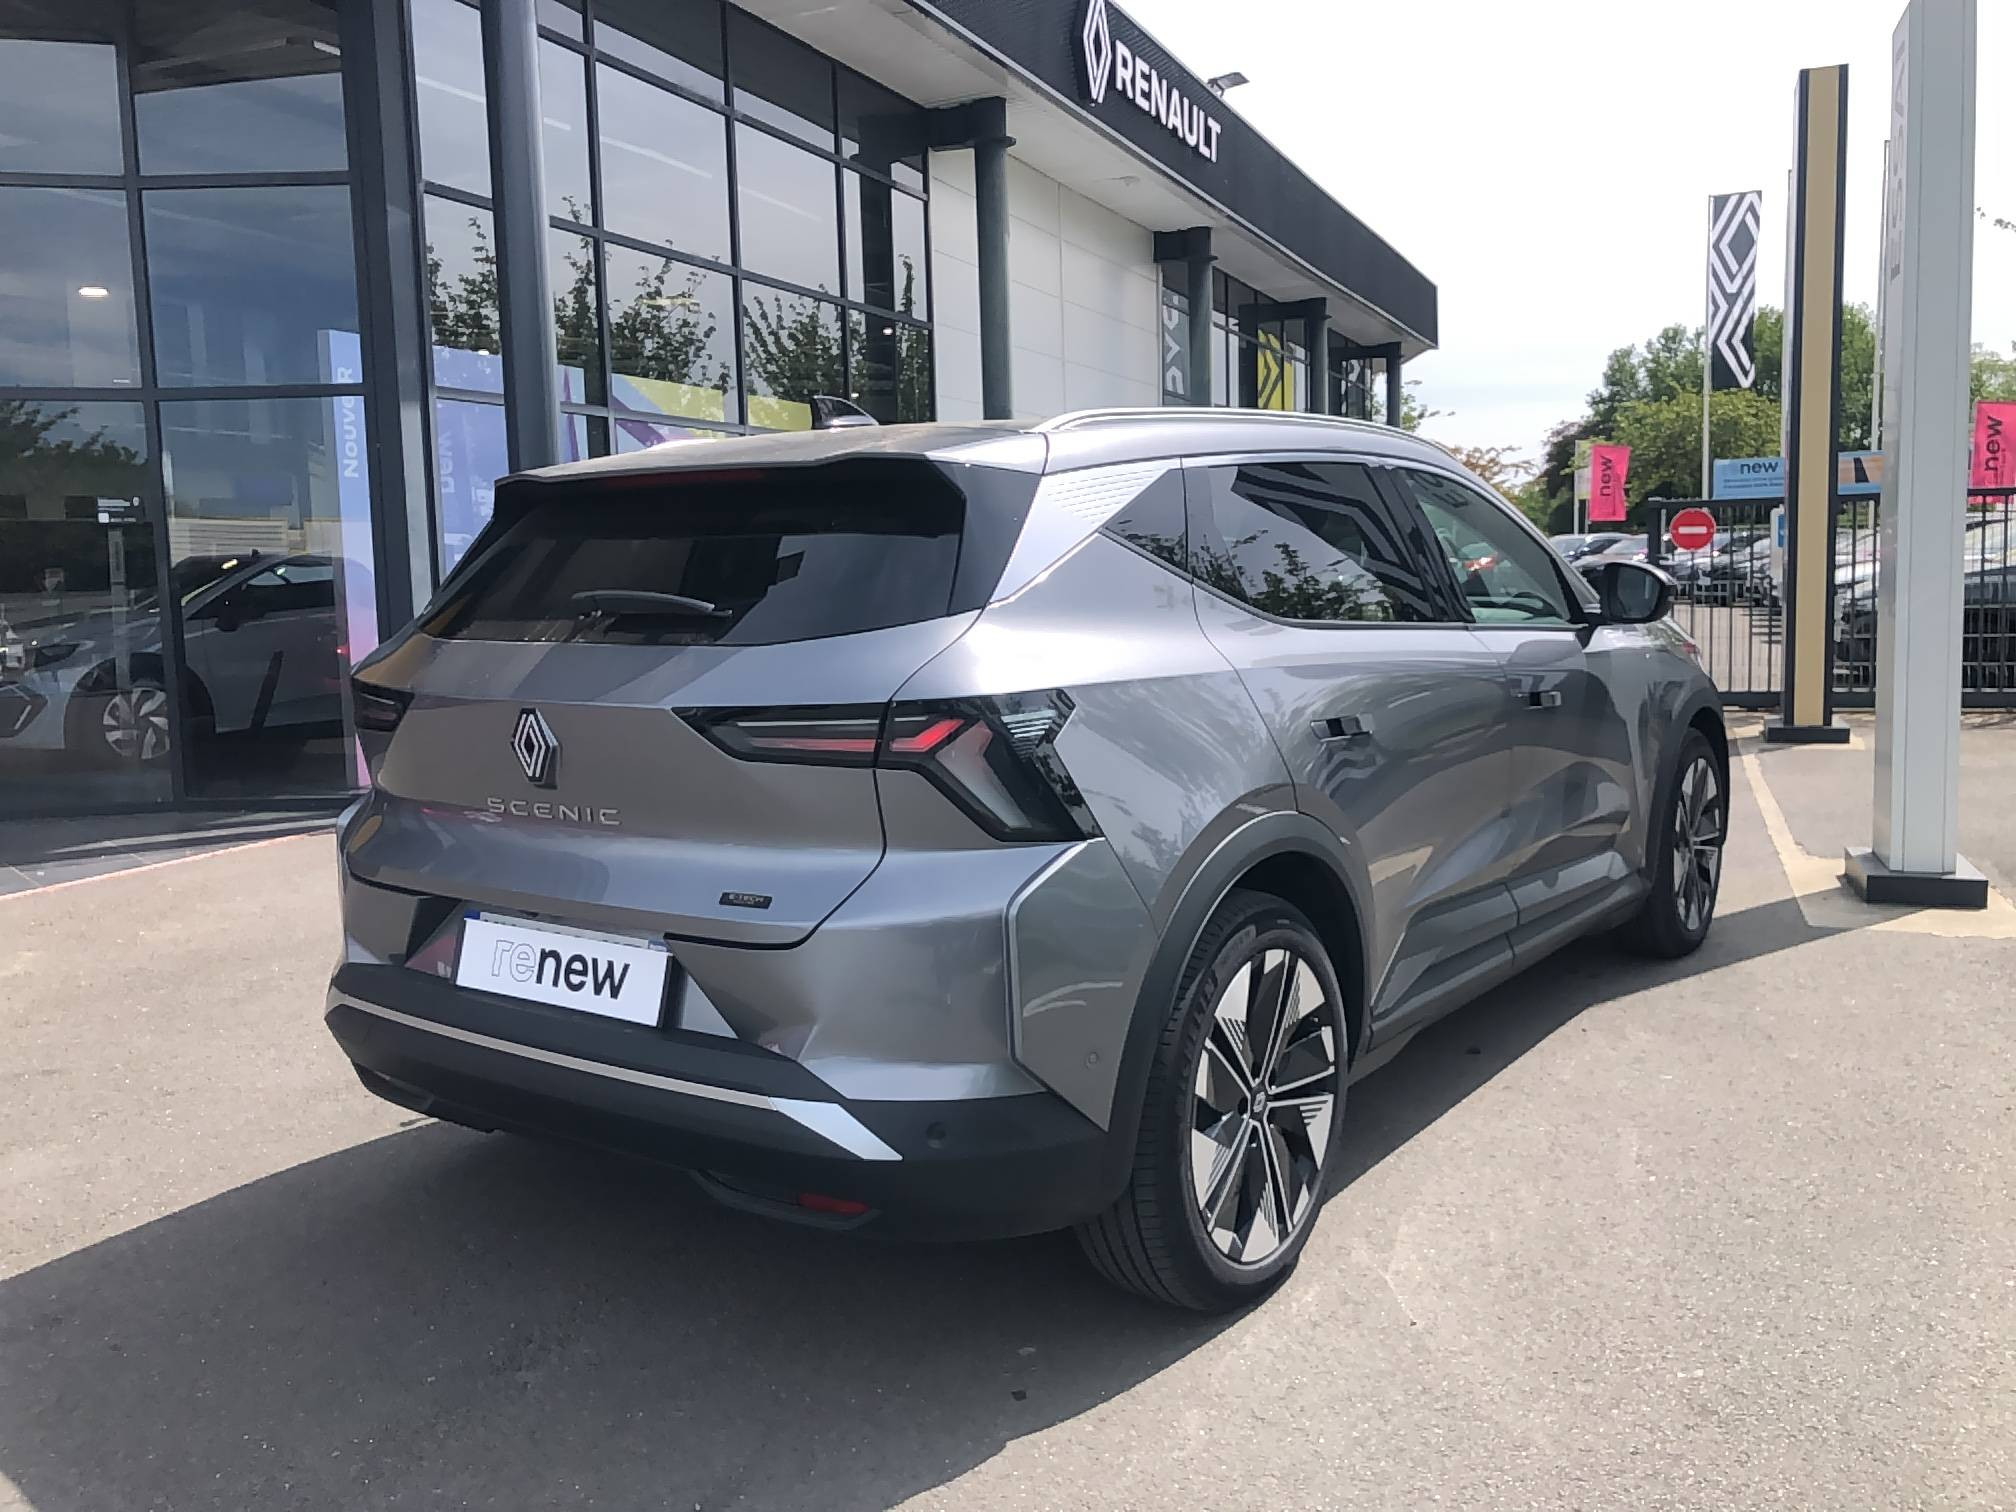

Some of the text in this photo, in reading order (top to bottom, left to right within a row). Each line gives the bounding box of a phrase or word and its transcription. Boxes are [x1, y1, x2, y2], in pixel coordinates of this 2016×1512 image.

[1116, 39, 1221, 163] RENAULT
[1985, 415, 2003, 471] new
[1600, 455, 1612, 496] new
[1740, 461, 1778, 474] new
[487, 797, 621, 825] SCENIC
[491, 939, 630, 1000] renew
